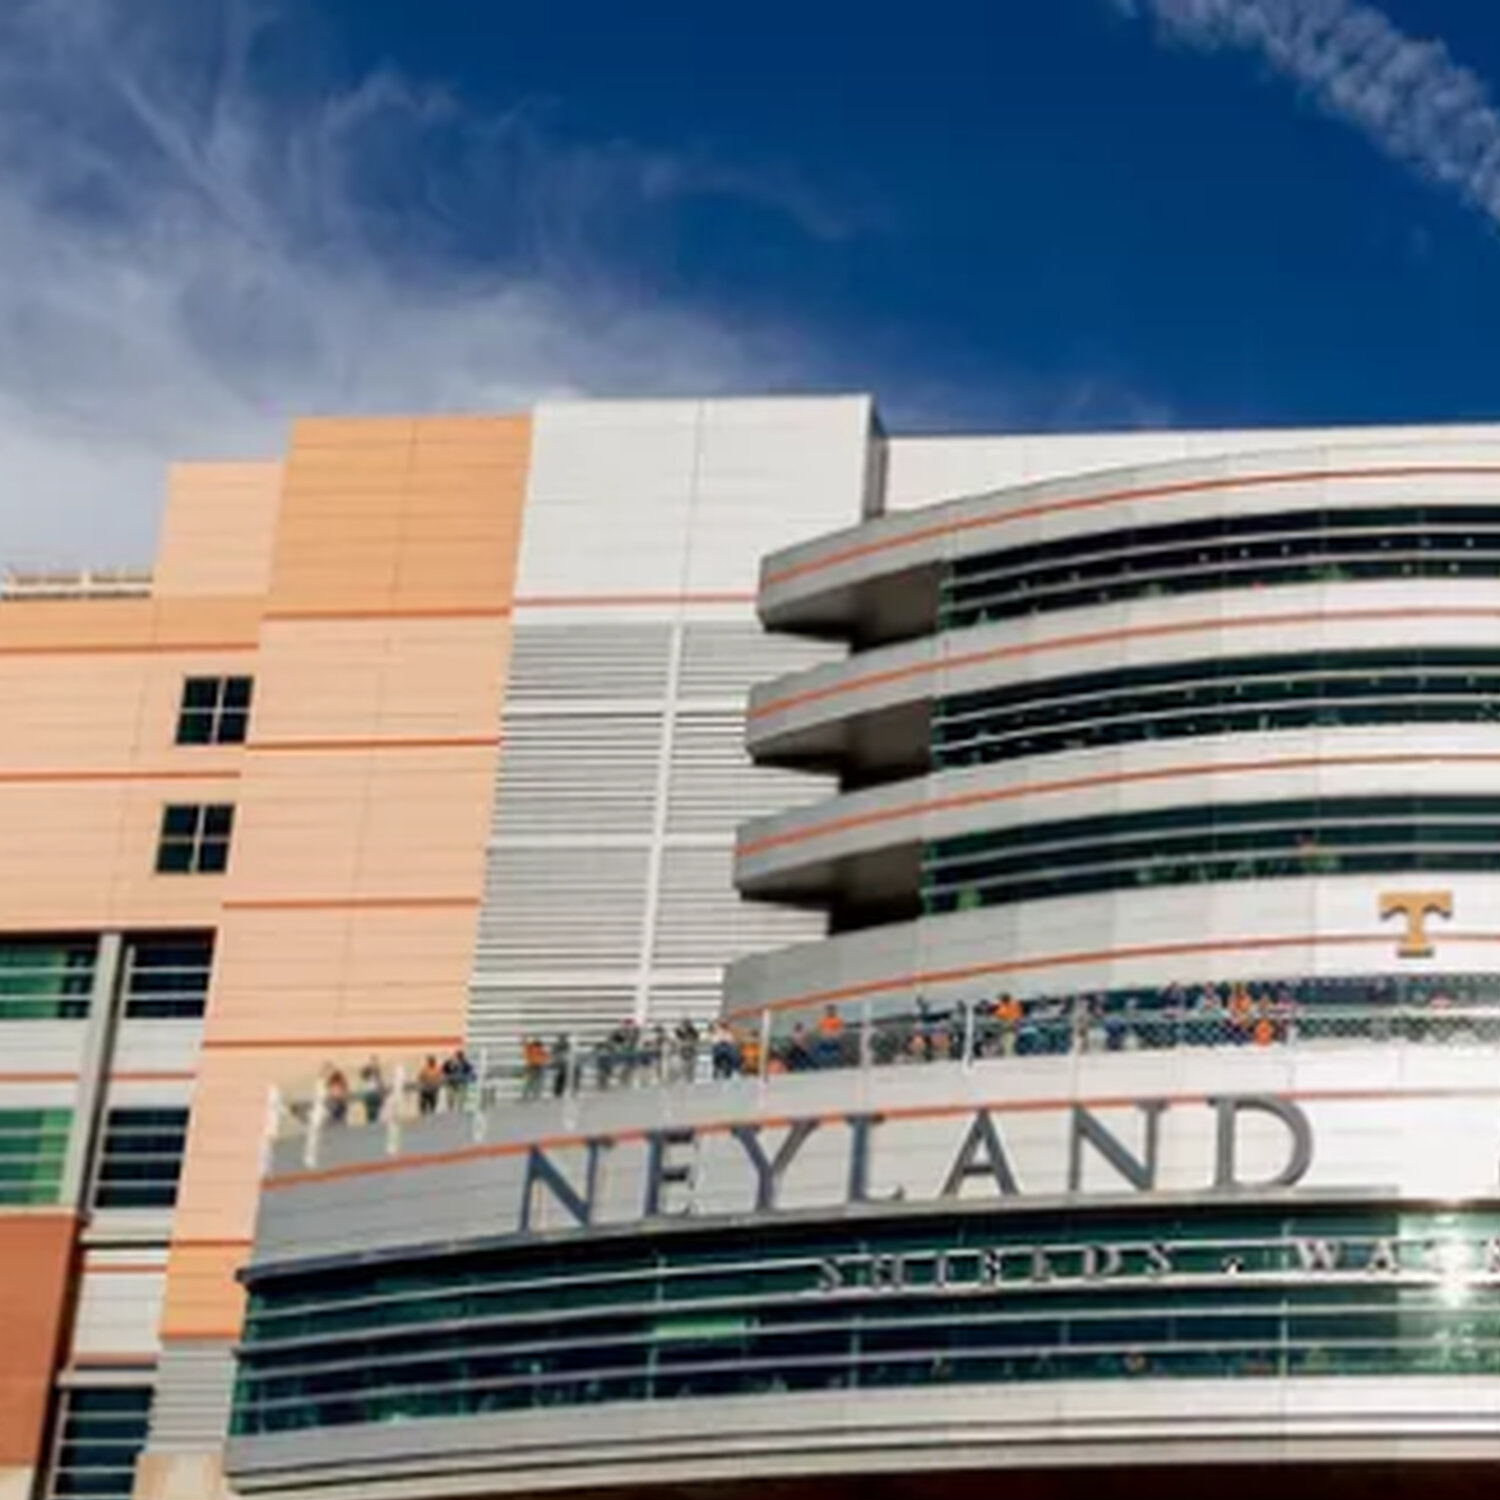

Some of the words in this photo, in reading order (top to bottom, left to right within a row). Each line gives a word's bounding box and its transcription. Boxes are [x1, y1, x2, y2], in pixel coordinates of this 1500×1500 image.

[1379, 891, 1452, 959] T
[517, 1094, 1315, 1235] NEYLAND
[818, 1242, 1172, 1292] SHIELDS
